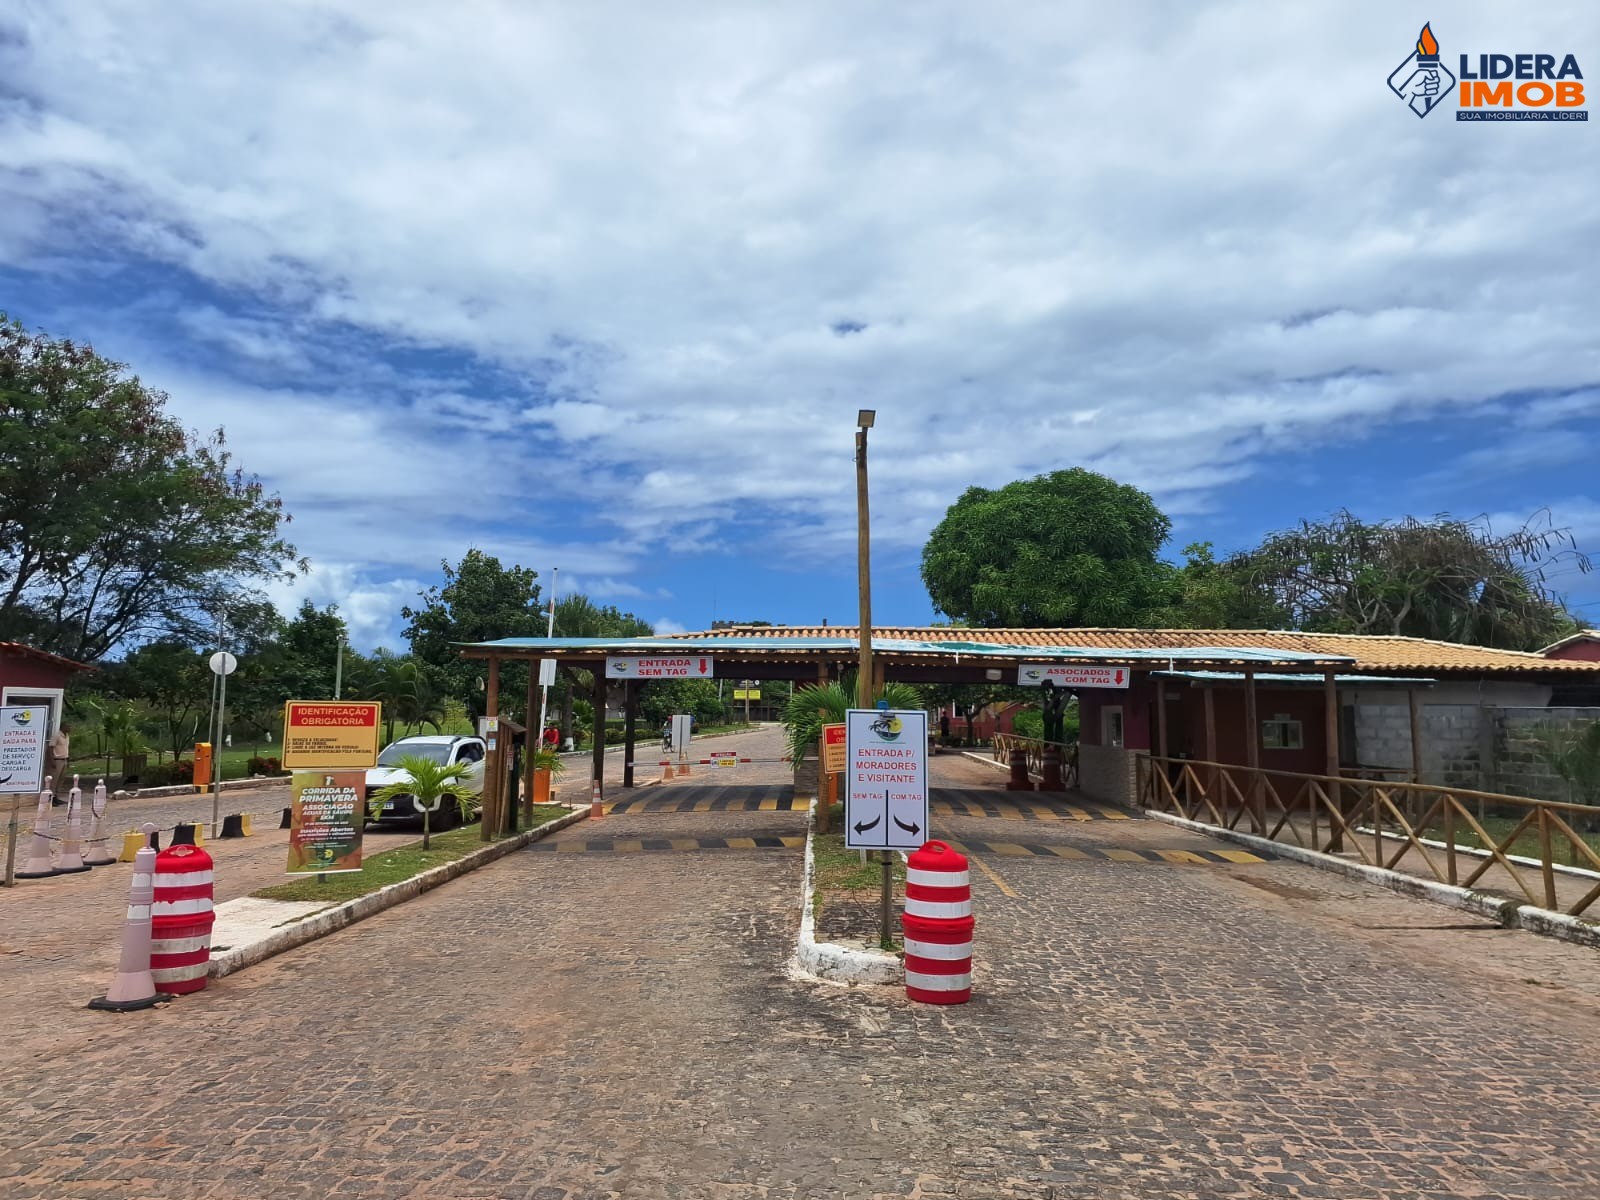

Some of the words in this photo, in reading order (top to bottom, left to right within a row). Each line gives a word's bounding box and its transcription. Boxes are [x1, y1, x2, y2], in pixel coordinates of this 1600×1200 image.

[638, 658, 691, 667] ENTRADA
[638, 668, 662, 676] SEM
[1047, 668, 1111, 676] ASSOCIADOS
[298, 706, 369, 717] IDENTIFICAÇÃO
[301, 716, 365, 725] OBRIGATÓRIA
[858, 748, 904, 758] ENTRADA
[905, 749, 914, 758] P/
[856, 761, 917, 771] MORADORES
[858, 773, 865, 782] E
[867, 773, 915, 783] VISITANTE
[302, 787, 341, 795] CORRIDA
[299, 794, 359, 803] PRIMAVERA
[869, 792, 883, 800] TAG
[908, 793, 922, 801] TAG
